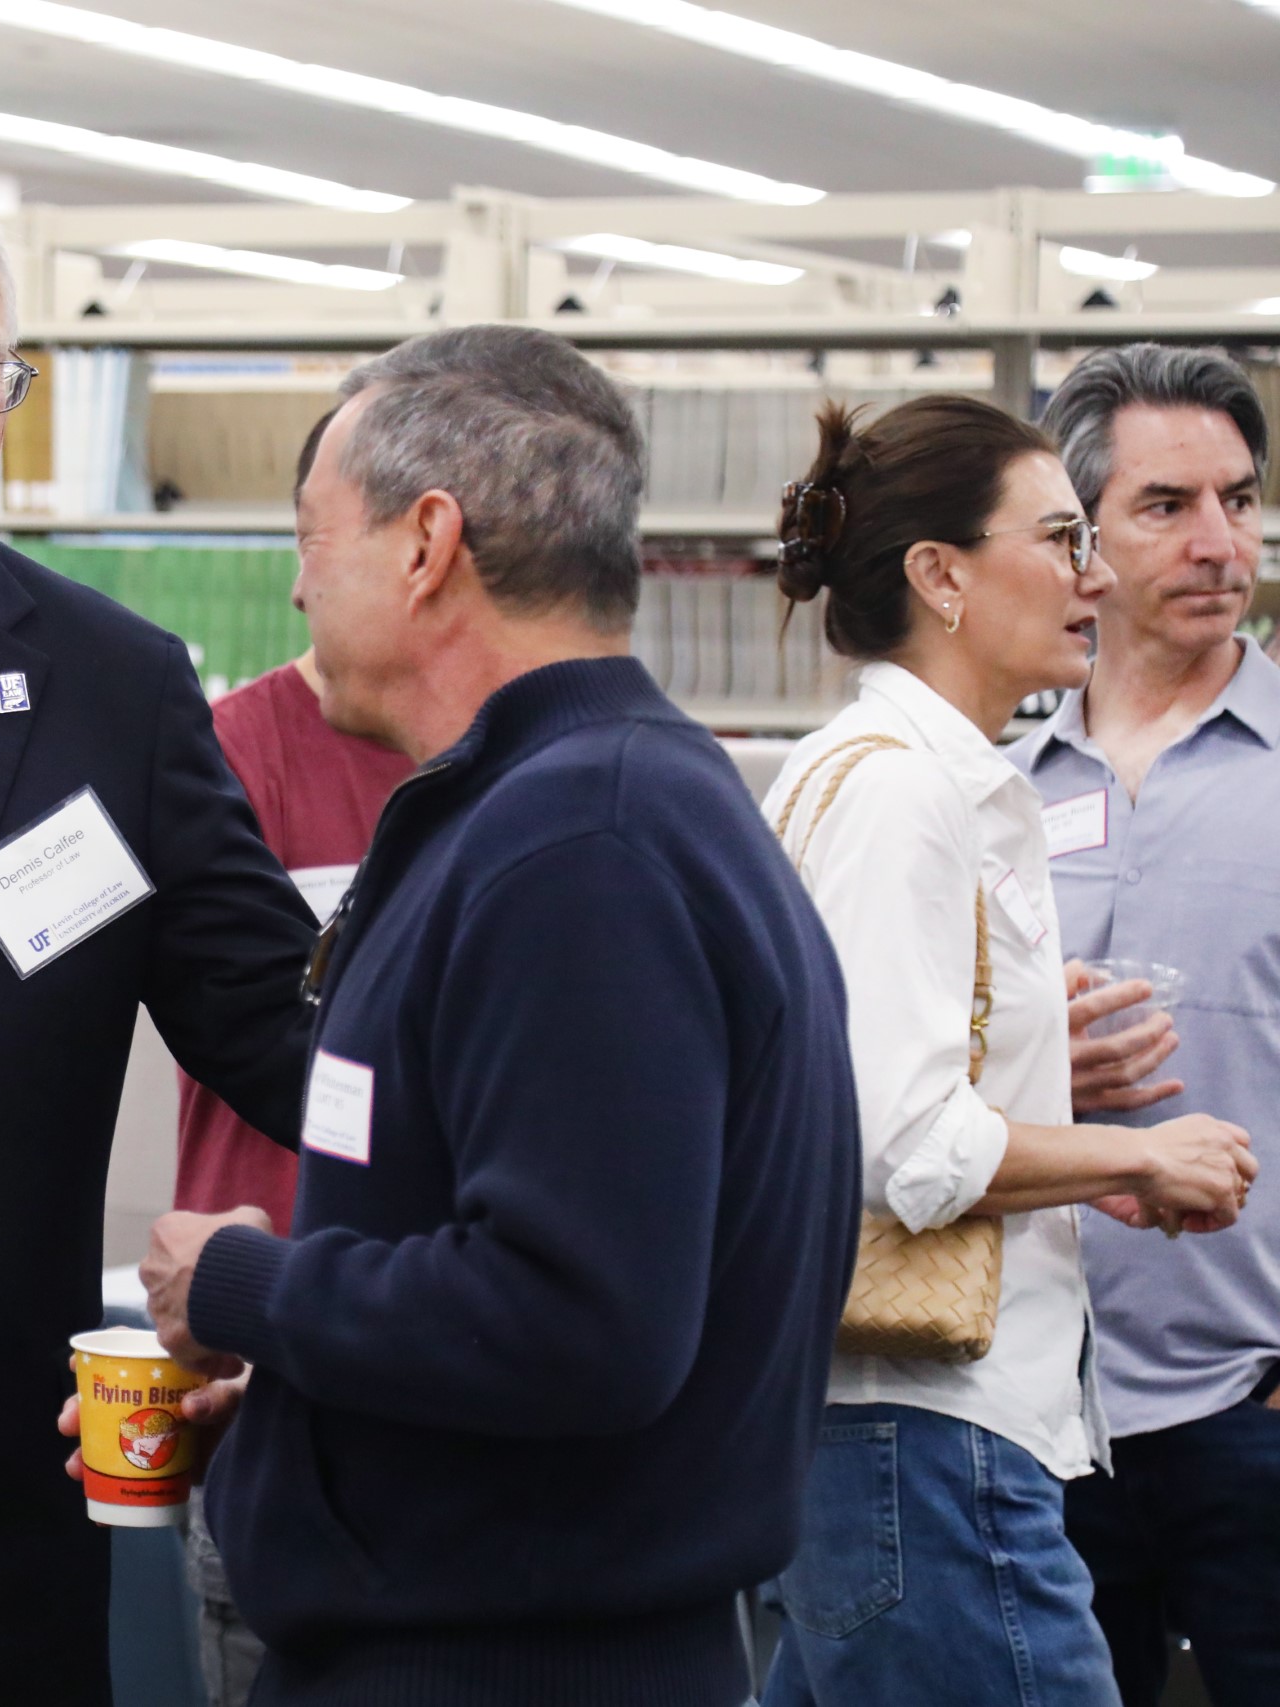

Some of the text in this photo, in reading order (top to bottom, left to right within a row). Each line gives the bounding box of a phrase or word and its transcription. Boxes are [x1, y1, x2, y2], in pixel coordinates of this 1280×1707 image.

[0, 676, 23, 690] UF
[2, 688, 24, 698] LAW
[43, 829, 85, 860] Calfee
[19, 851, 81, 894] Professor of Law
[52, 880, 124, 930] Levin College of Law
[58, 889, 130, 939] UNIVERSITY of FLORIDA
[28, 928, 51, 953] UF
[94, 1382, 200, 1406] Flying Bisc
